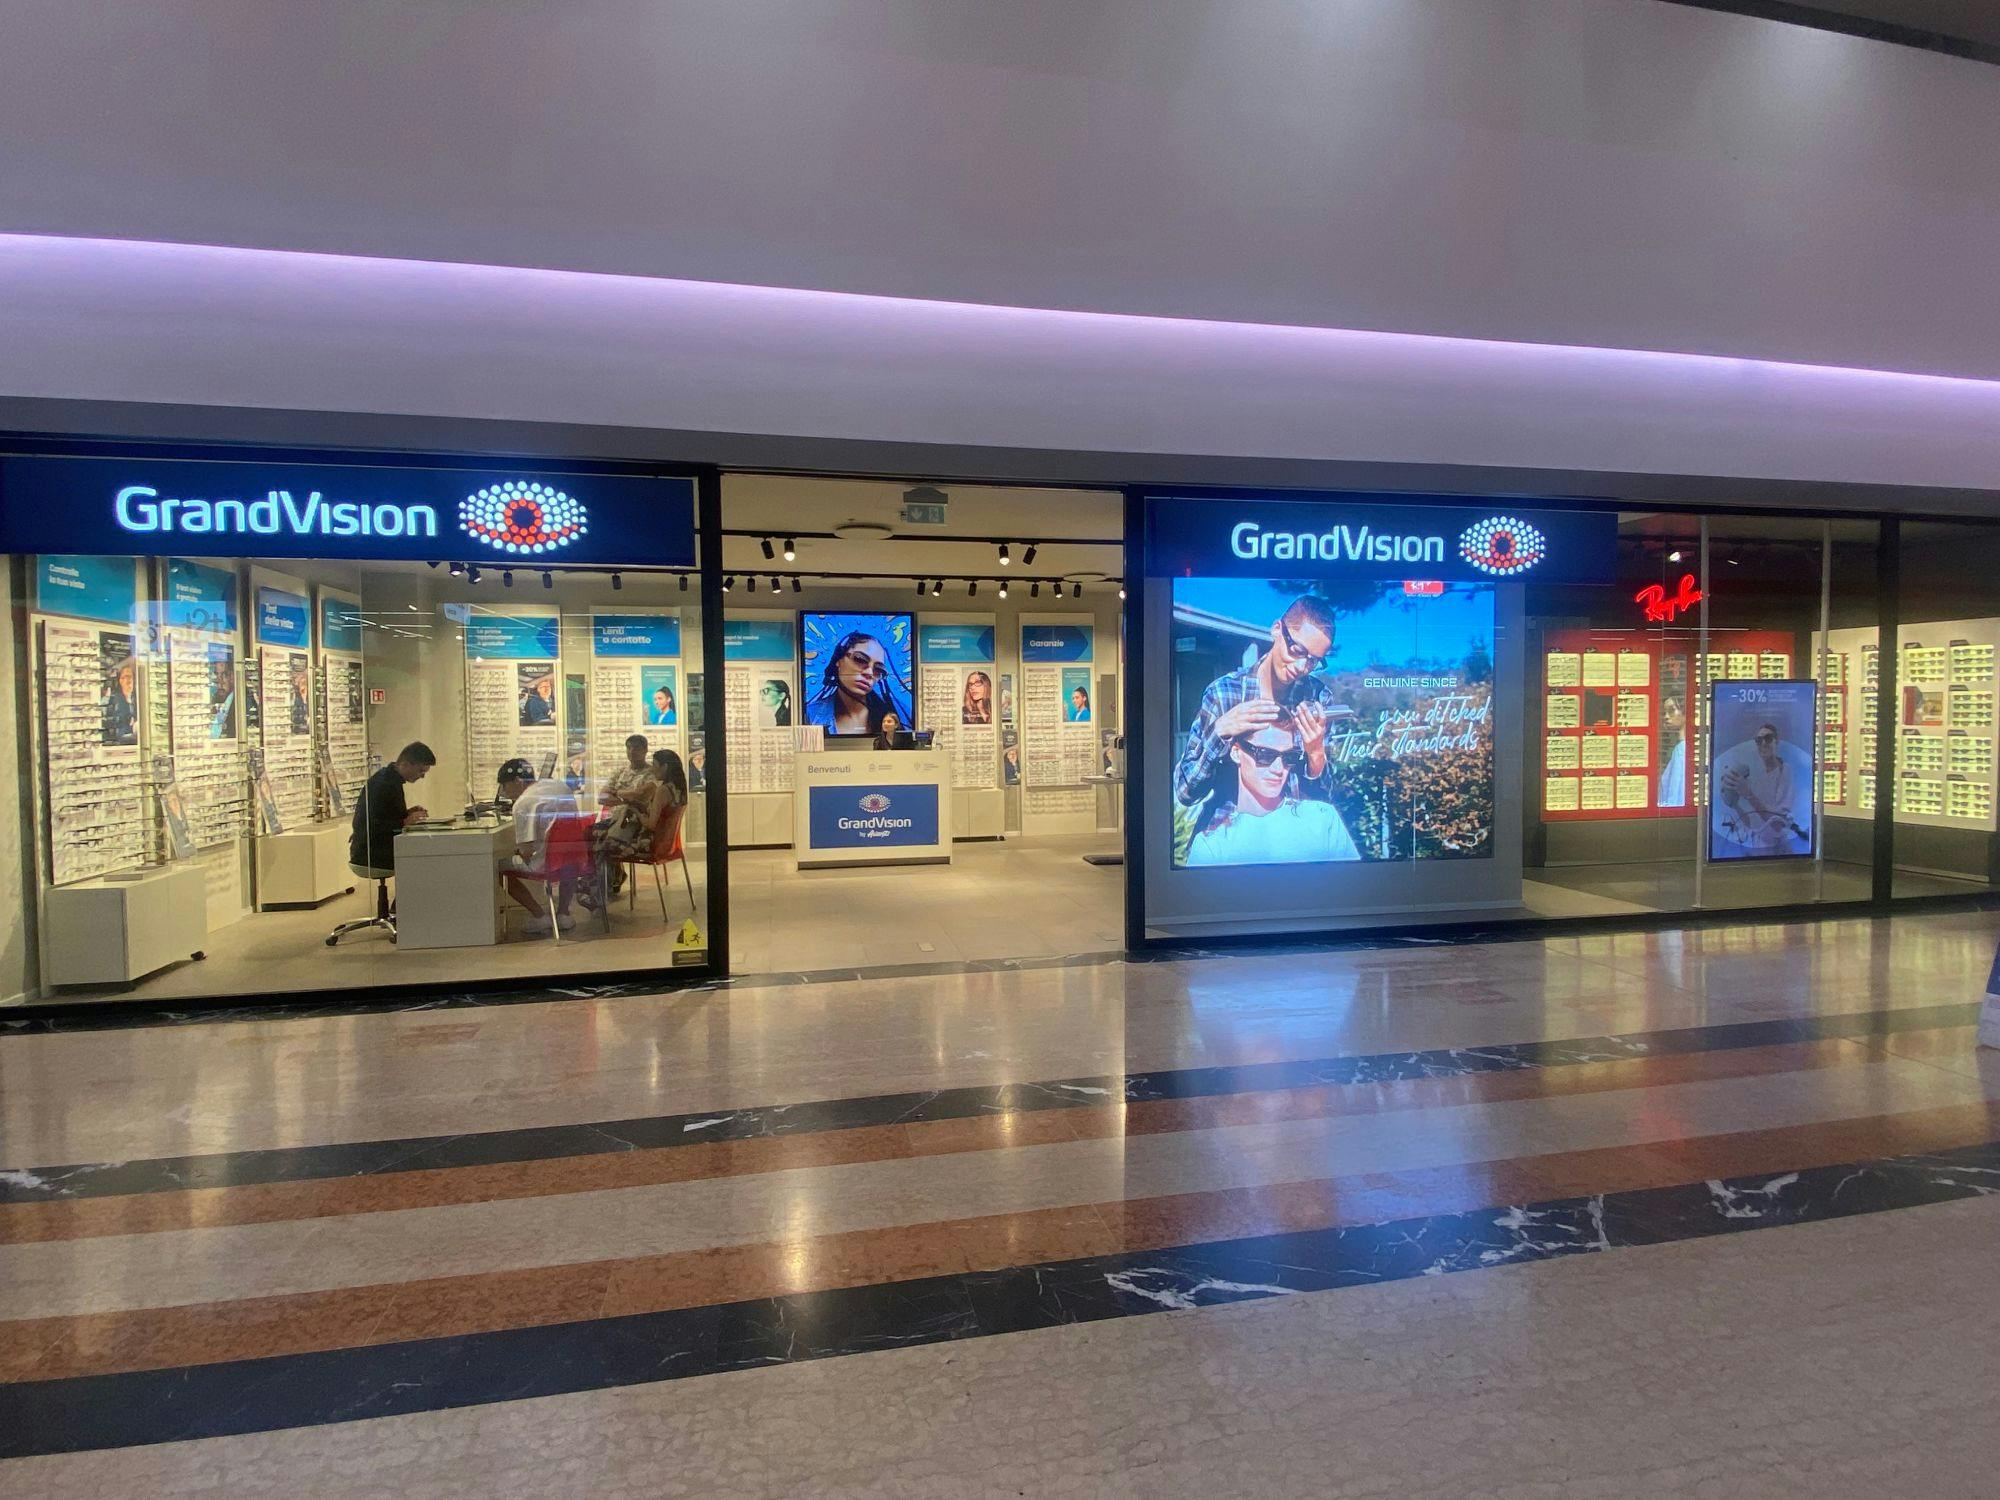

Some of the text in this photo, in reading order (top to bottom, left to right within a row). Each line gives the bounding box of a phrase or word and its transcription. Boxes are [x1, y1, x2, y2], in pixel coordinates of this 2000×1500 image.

[116, 486, 436, 537] GrandVision
[1231, 522, 1444, 562] GrandVision
[603, 626, 625, 635] Lenti
[611, 636, 652, 644] contatto
[1363, 676, 1458, 688] GENUINE SINCE
[1730, 688, 1767, 703] -30%
[1375, 707, 1420, 738] you
[807, 764, 851, 774] Benvenuti
[838, 817, 912, 829] GrandVision
